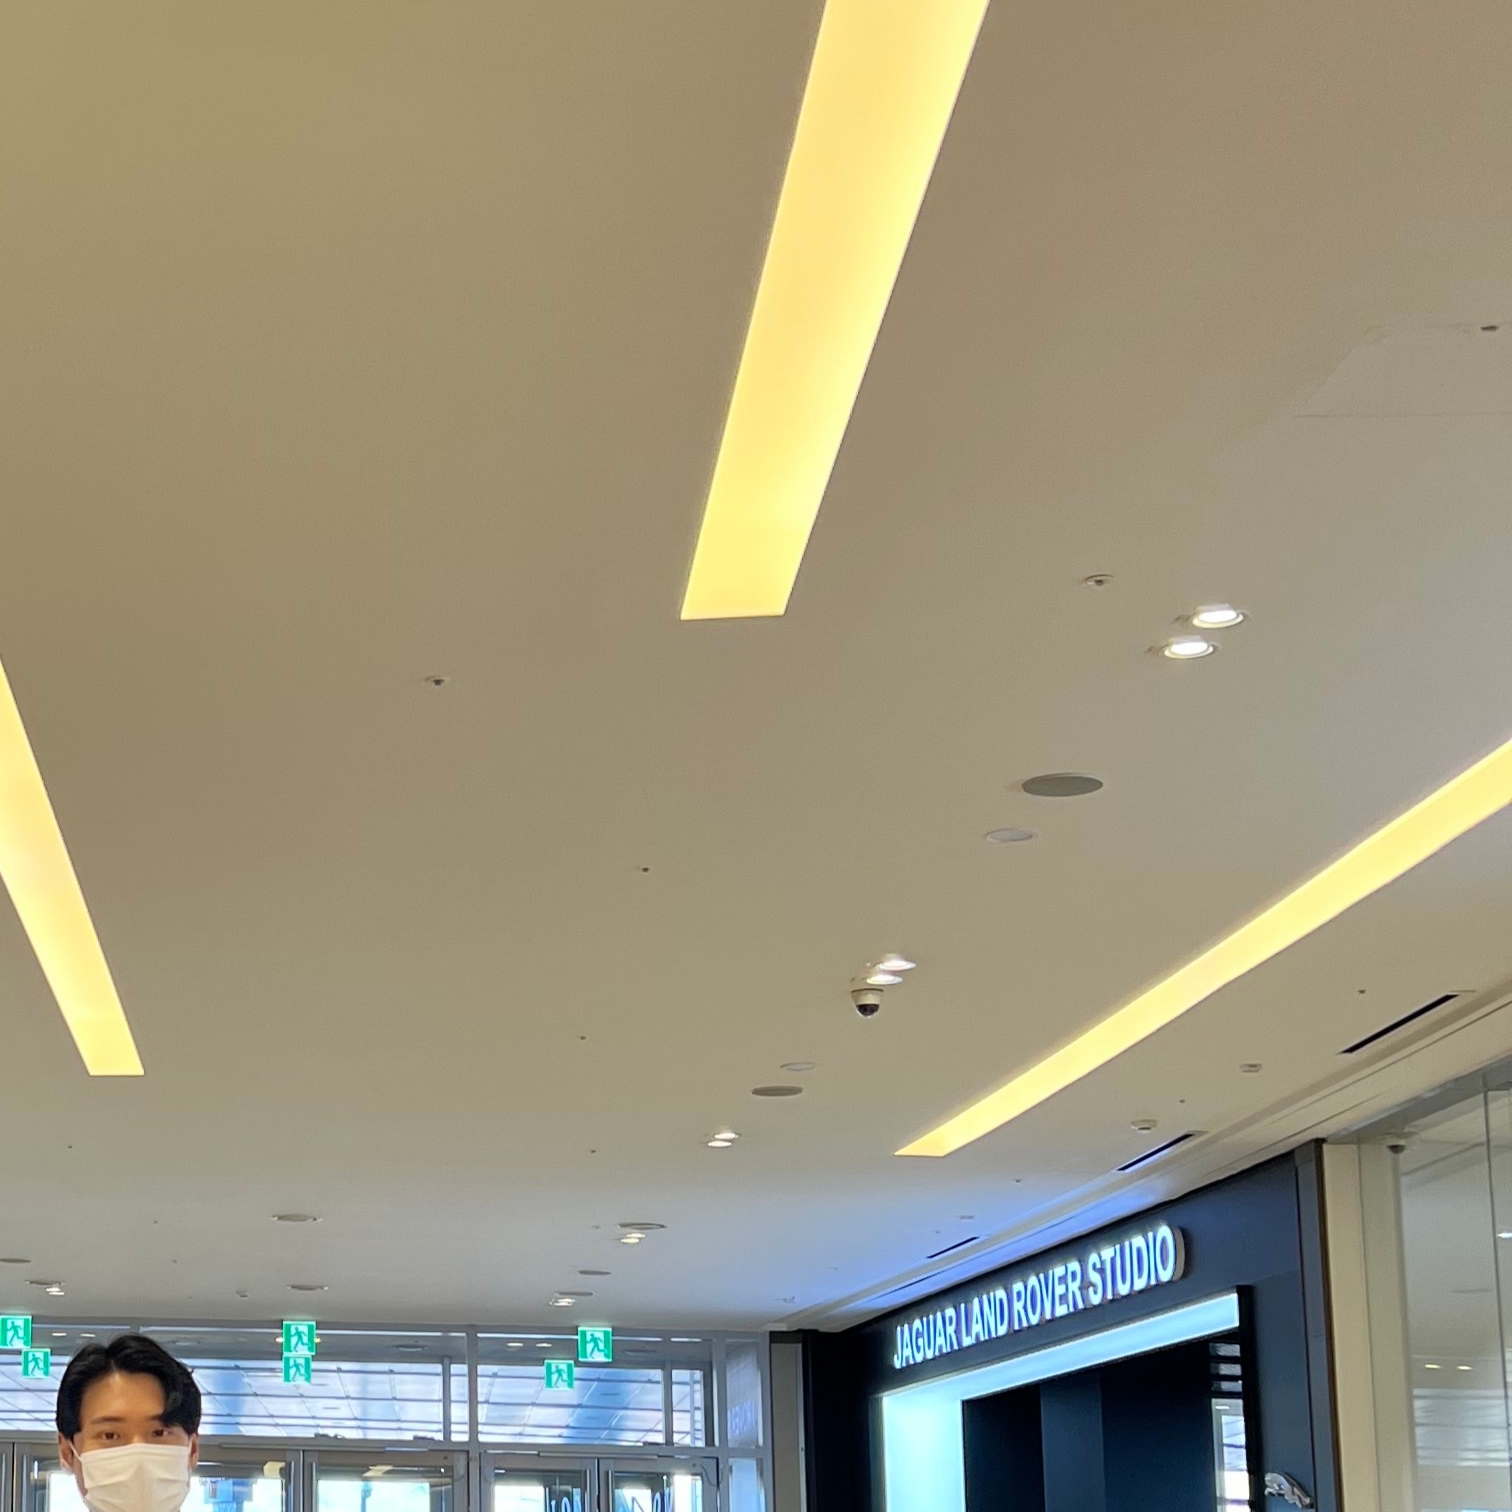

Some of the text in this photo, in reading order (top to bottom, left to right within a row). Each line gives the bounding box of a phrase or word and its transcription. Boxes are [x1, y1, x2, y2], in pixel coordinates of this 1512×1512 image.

[893, 1225, 1176, 1369] JAGUAR LAND ROVER STUDIO
